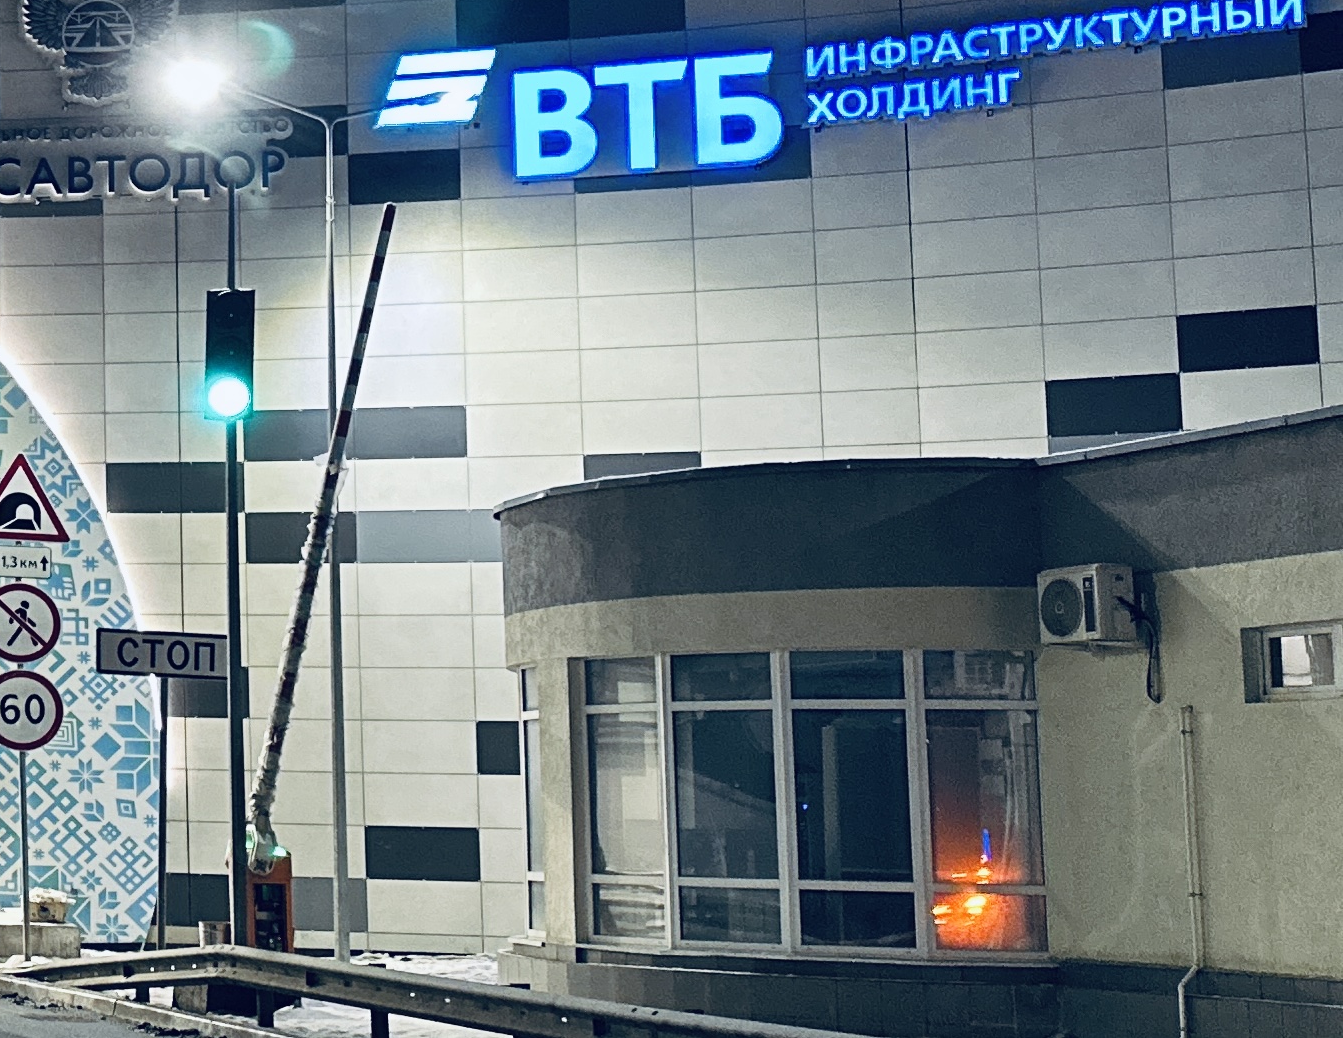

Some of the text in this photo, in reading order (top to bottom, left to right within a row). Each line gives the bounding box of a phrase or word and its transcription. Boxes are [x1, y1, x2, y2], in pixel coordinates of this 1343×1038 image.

[808, 68, 1020, 123] ХОЛДИНГ
[512, 50, 784, 177] ВТБ
[1, 556, 18, 569] 1,3
[117, 638, 216, 672] СТОП
[0, 693, 46, 725] 60
